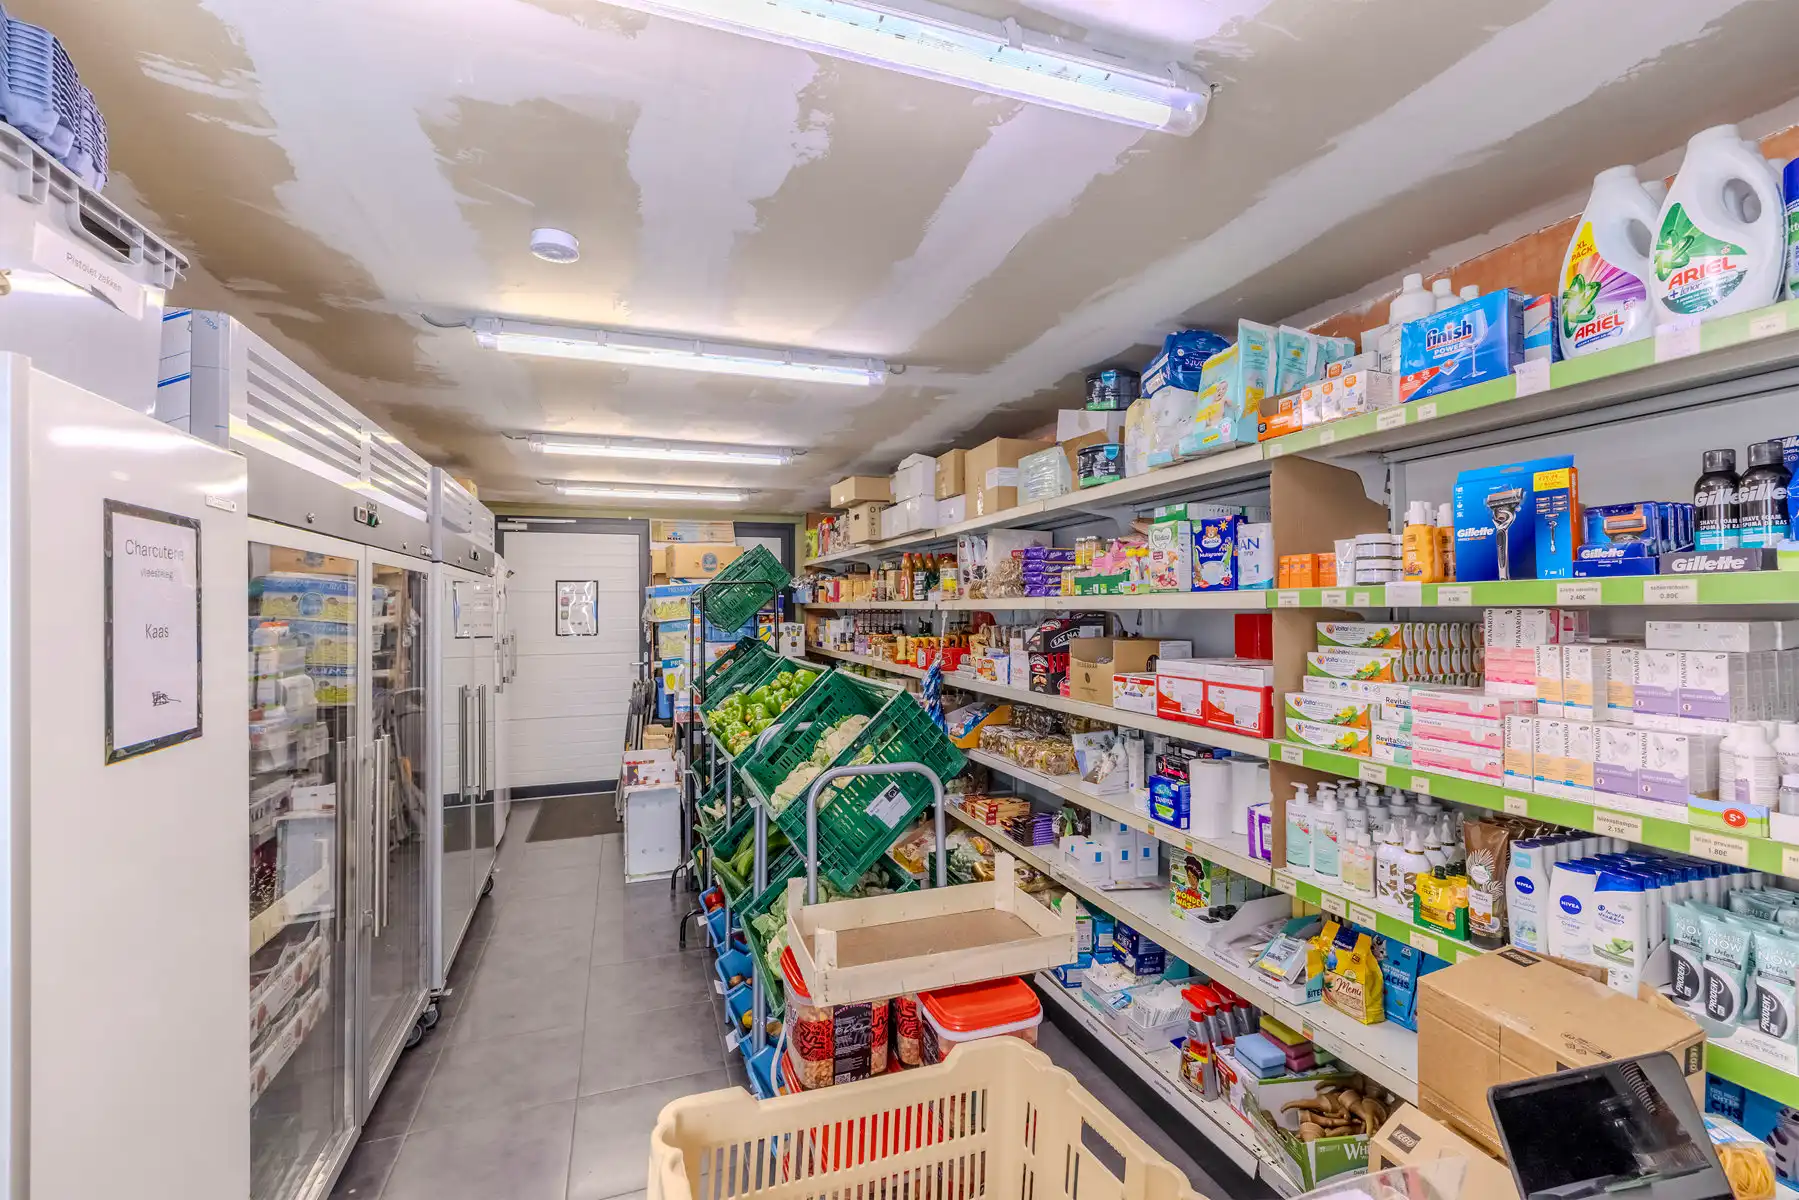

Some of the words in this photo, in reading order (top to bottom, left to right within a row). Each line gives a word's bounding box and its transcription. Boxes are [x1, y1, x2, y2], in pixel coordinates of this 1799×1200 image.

[1571, 246, 1593, 262] PACK
[1577, 241, 1587, 250] XL
[1668, 257, 1736, 290] ARIEL
[1426, 320, 1473, 348] finish
[1574, 314, 1625, 341] ARIEL
[1457, 526, 1495, 538] Gillette
[1581, 548, 1625, 559] Gillette
[1671, 555, 1746, 572] Gillette
[145, 623, 170, 640] Kaas
[1053, 634, 1066, 646] EAT
[1679, 652, 1687, 688] PRANAROM
[1155, 795, 1174, 806] TAMPAX
[1516, 881, 1533, 890] NIVEA
[1561, 900, 1580, 910] NIVEA
[1708, 936, 1741, 953] NOW
[1758, 951, 1797, 968] NOW
[1385, 974, 1410, 989] ACHS
[1675, 959, 1686, 994] PRODENT
[1708, 976, 1720, 1013] PRODENT
[1760, 994, 1772, 1031] PRODENT
[1392, 1129, 1416, 1148] LEGO
